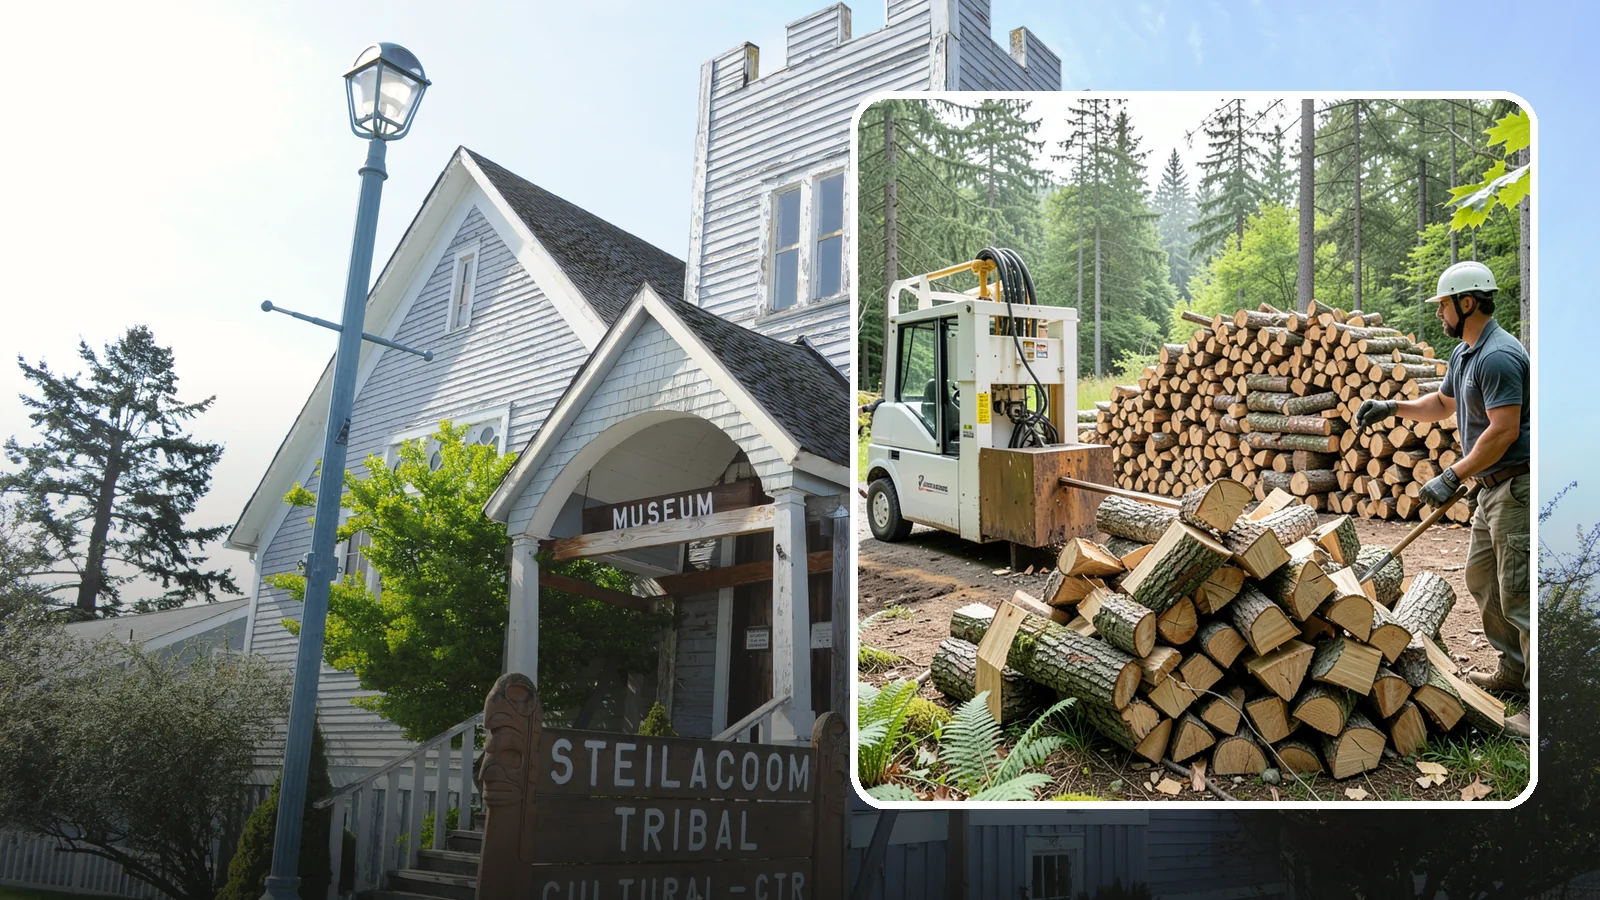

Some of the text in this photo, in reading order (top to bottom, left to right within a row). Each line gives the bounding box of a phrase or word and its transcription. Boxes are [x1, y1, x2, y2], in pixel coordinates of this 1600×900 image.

[613, 492, 713, 530] MUSEUM
[551, 738, 808, 792] STEILACOOM
[614, 806, 758, 852] TRIBAL
